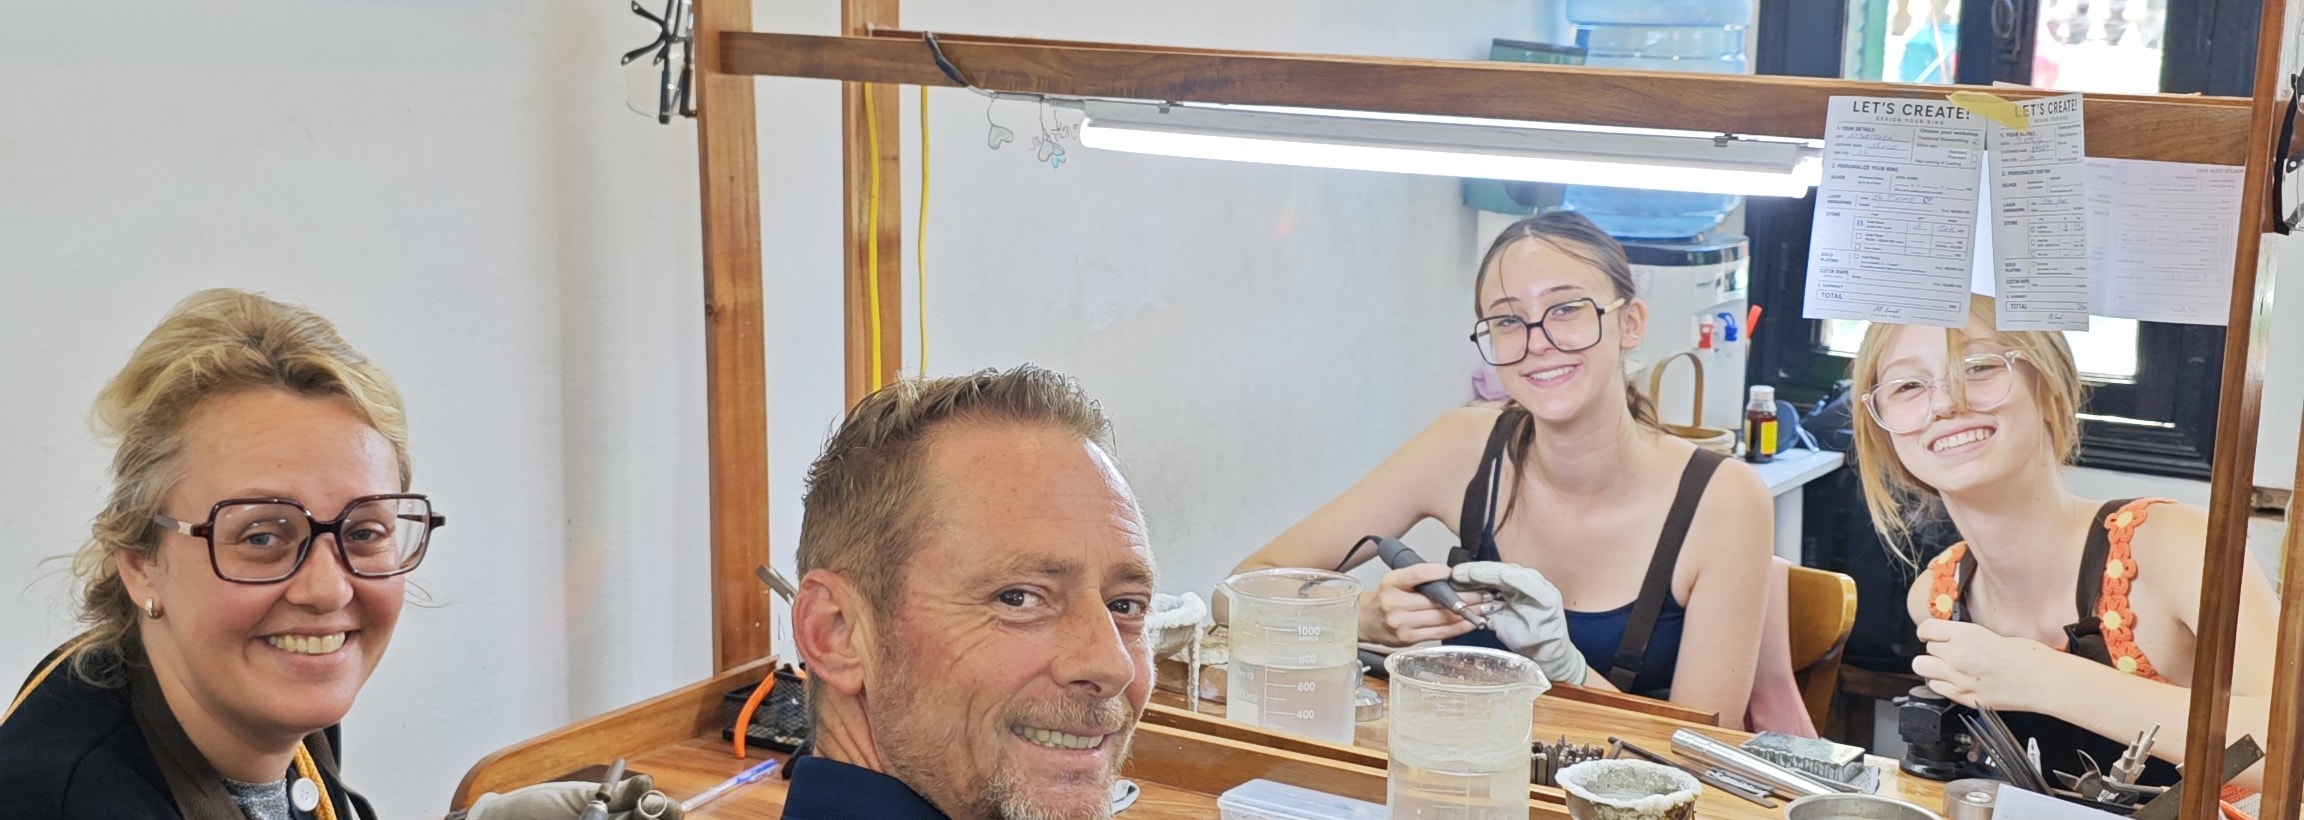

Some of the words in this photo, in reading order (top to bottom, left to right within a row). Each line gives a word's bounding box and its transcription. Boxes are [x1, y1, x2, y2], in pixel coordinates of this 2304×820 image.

[1852, 100, 1896, 114] LET'S
[1902, 104, 1971, 120] CREATE!
[2015, 104, 2044, 117] LET'S
[2048, 98, 2078, 114] CREATE!
[1298, 627, 1320, 635] 1000
[1299, 655, 1316, 663] 800
[1298, 682, 1316, 691] 600
[1296, 710, 1315, 719] 400
